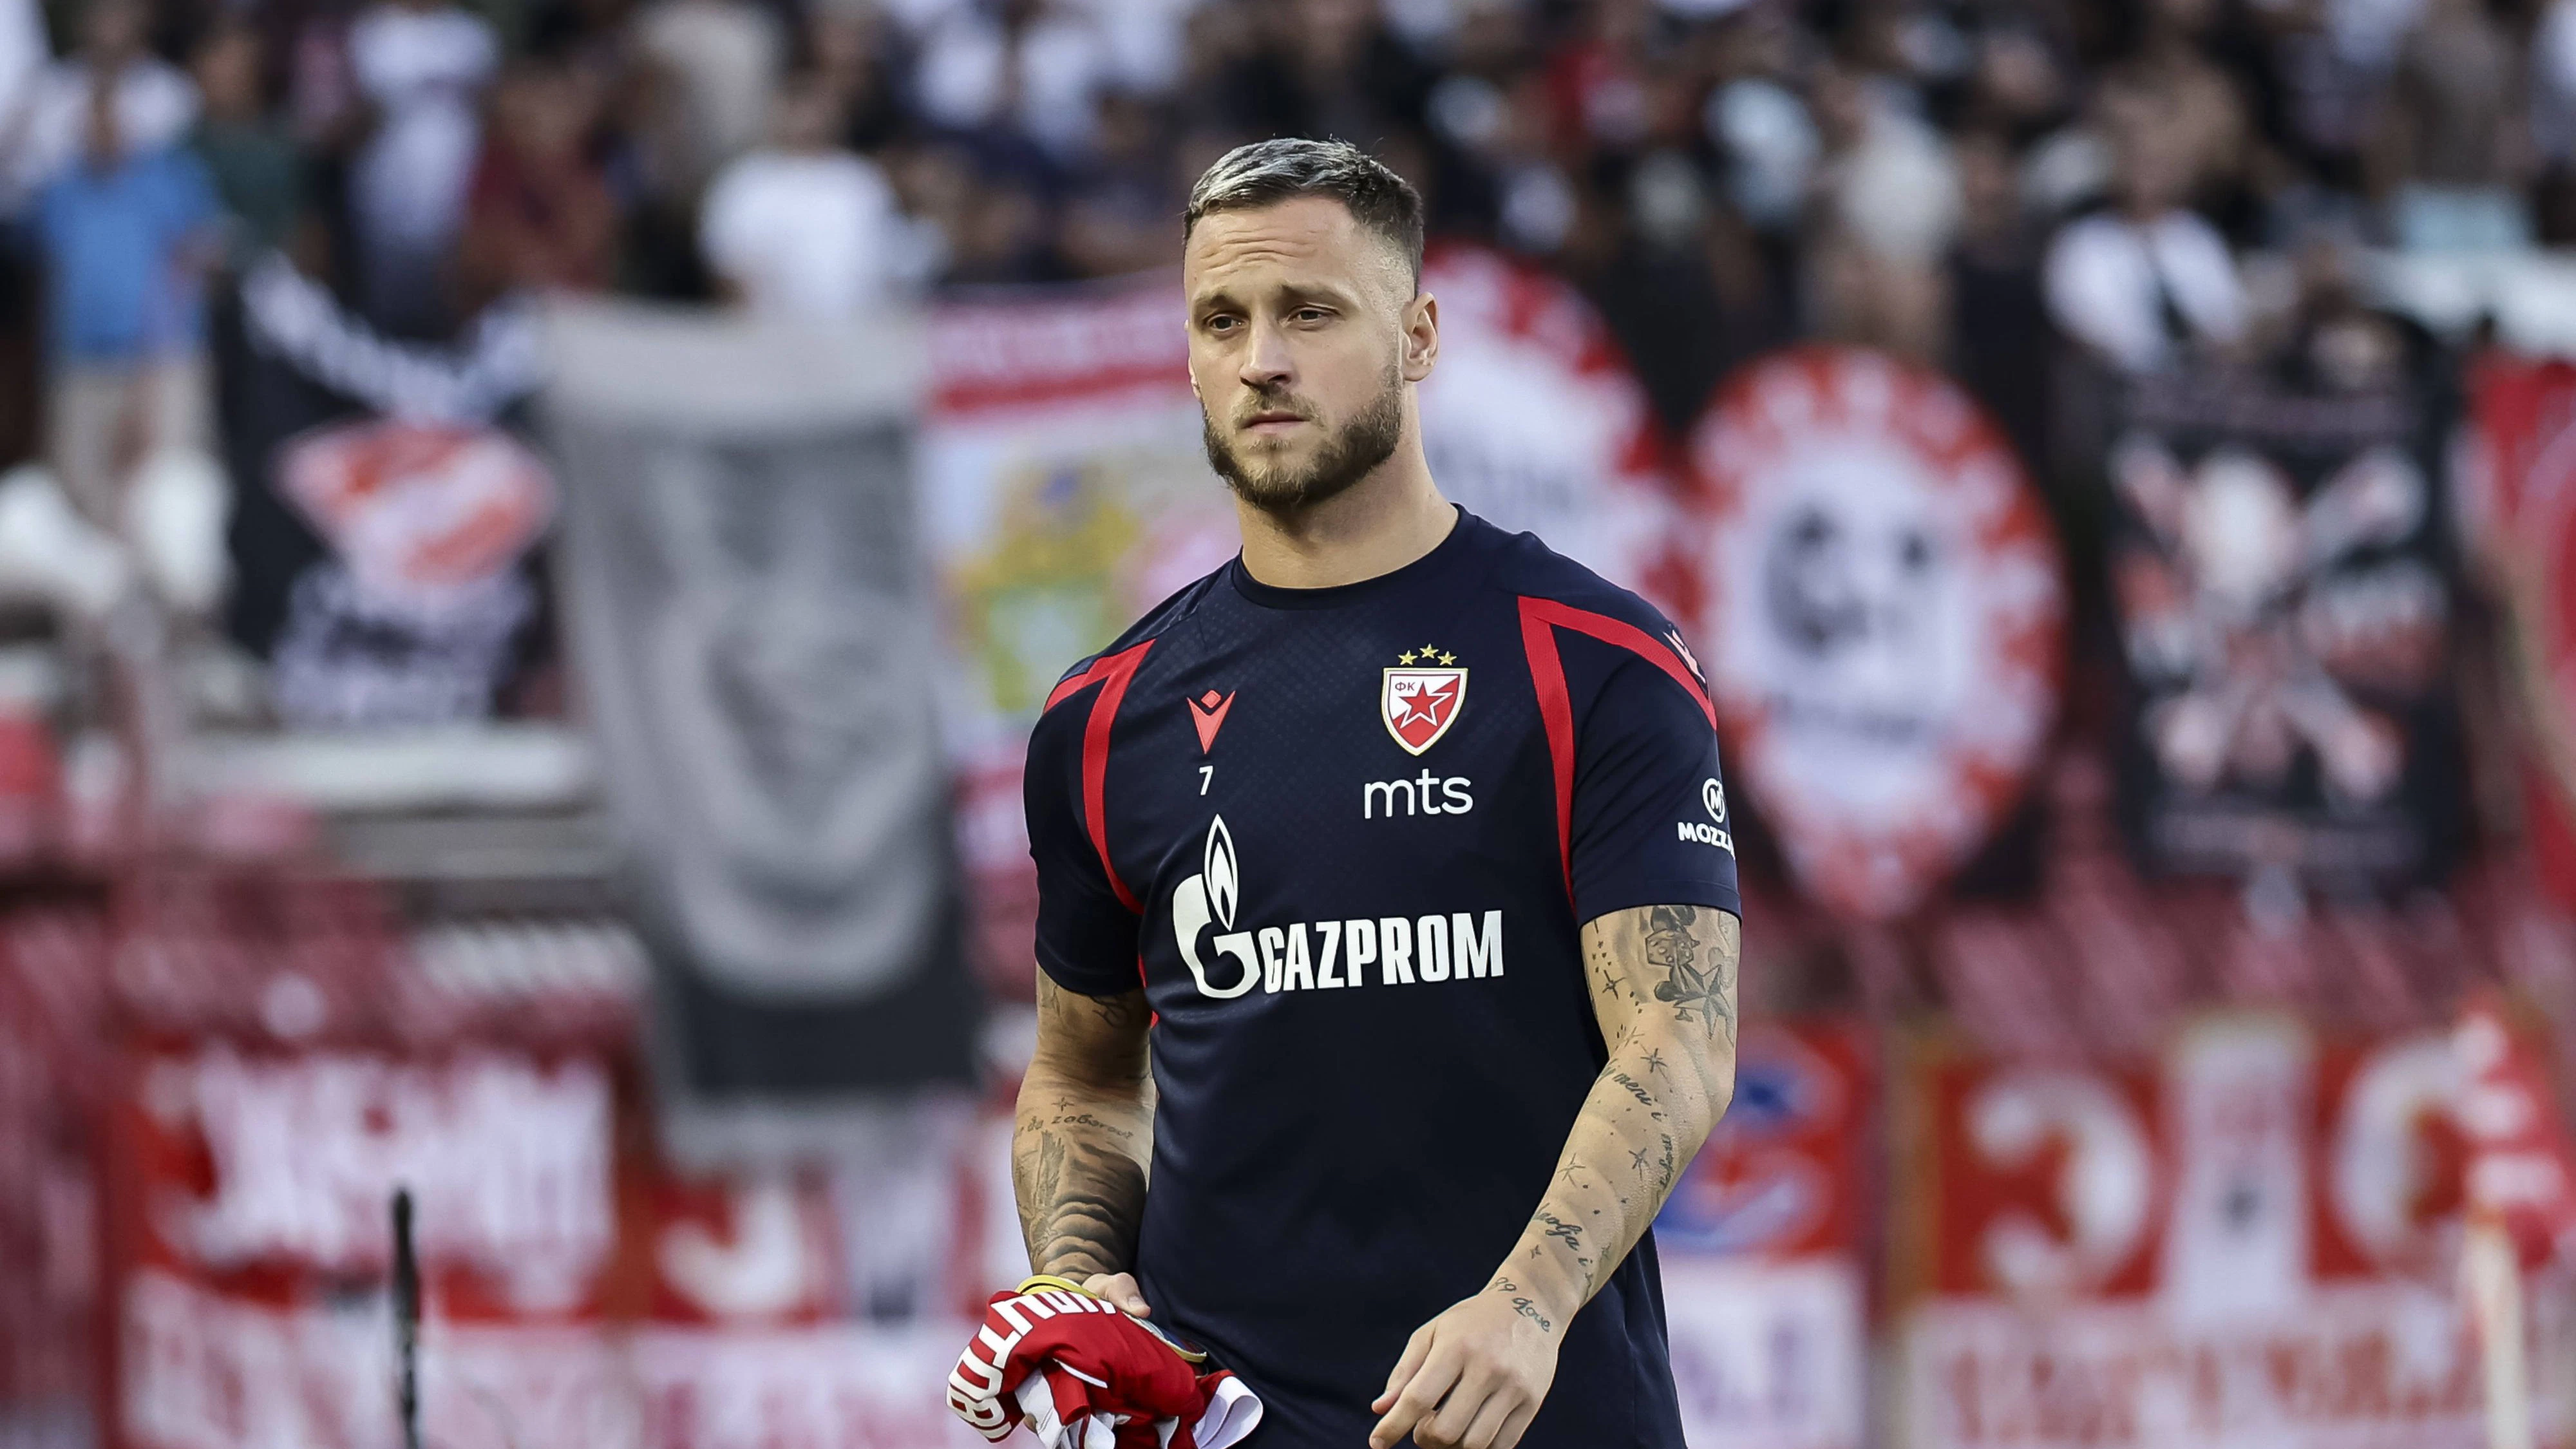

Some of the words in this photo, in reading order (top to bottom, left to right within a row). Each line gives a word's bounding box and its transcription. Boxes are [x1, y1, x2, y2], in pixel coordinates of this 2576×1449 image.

[1395, 681, 1416, 692] ФК
[1198, 765, 1214, 796] 7
[1364, 768, 1474, 819] mts
[1258, 909, 1504, 994] GAZPROM
